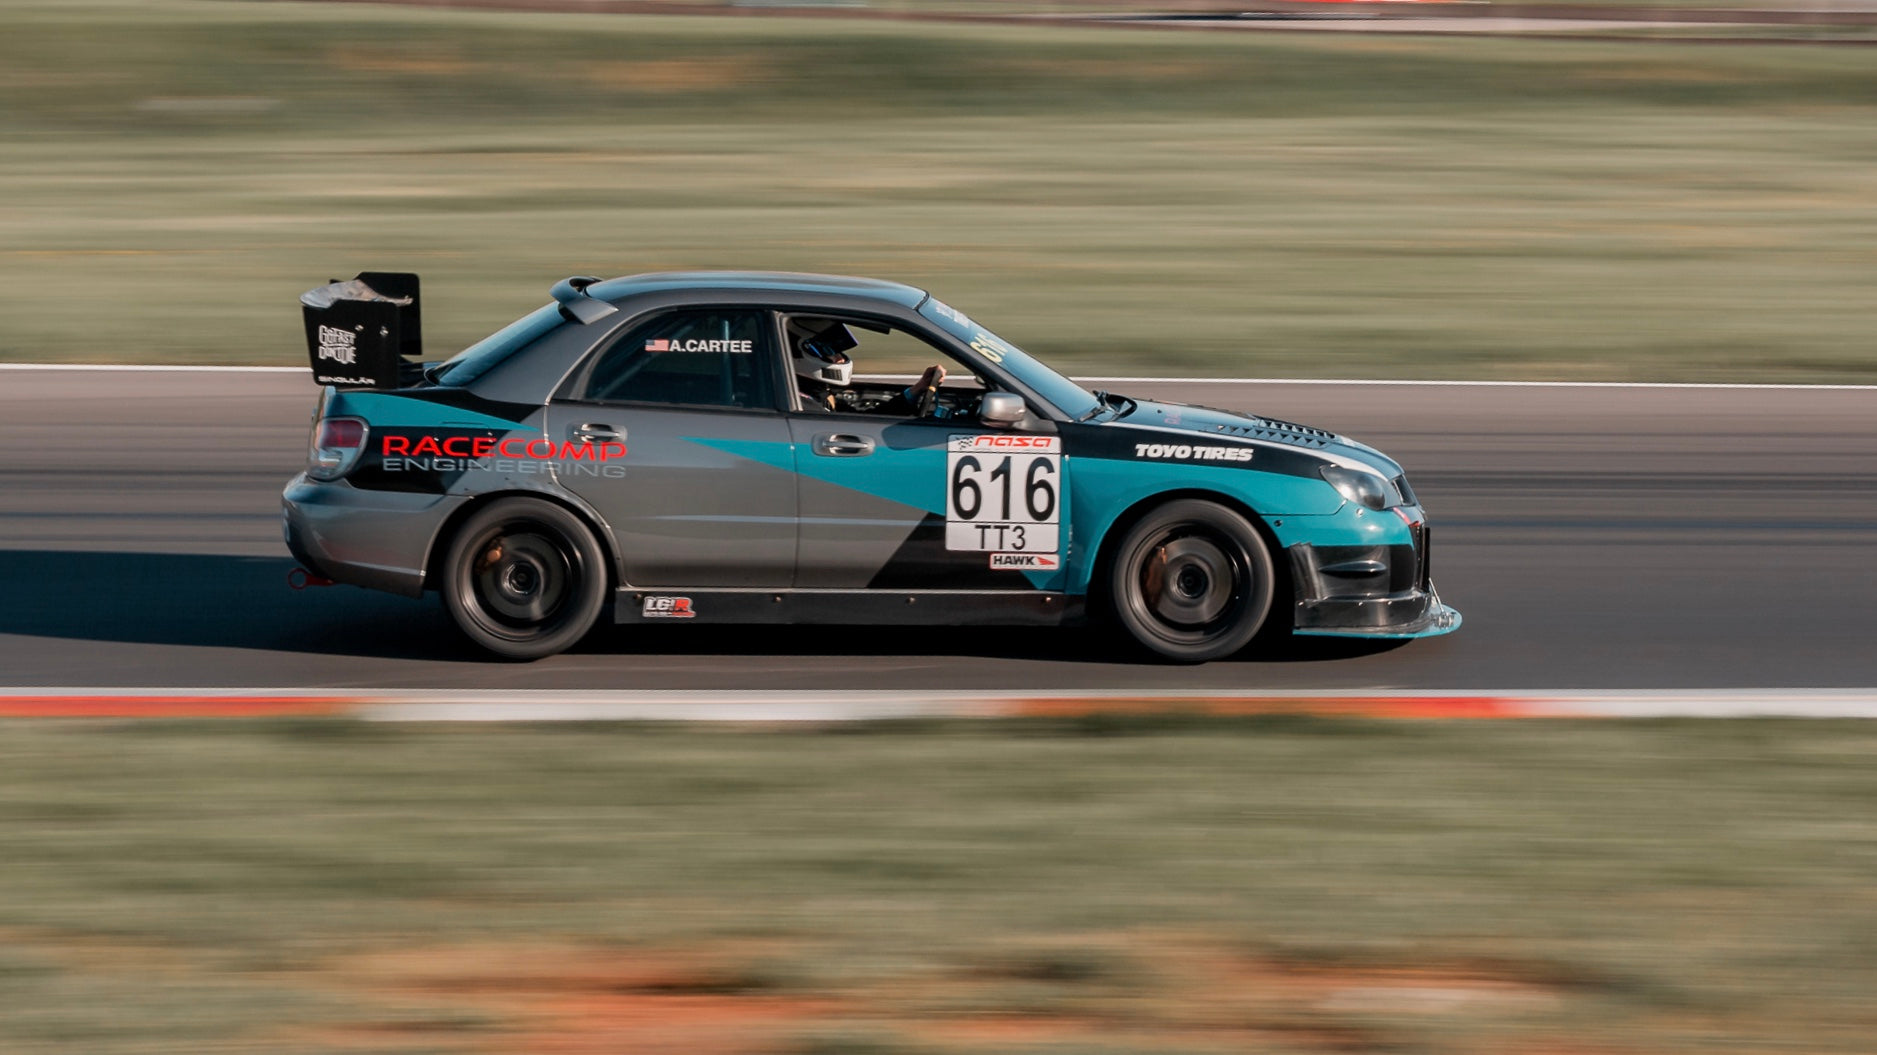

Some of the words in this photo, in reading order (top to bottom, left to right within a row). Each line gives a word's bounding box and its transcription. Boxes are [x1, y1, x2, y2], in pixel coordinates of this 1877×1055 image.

[669, 339, 753, 353] A.CARTEE
[382, 435, 628, 462] RACECOMP
[1135, 444, 1192, 459] TOYO
[1192, 446, 1254, 462] TIRES
[382, 458, 627, 479] ENGINEERING
[952, 455, 1055, 522] 616
[975, 525, 1026, 550] TT3
[993, 556, 1035, 566] HAWK
